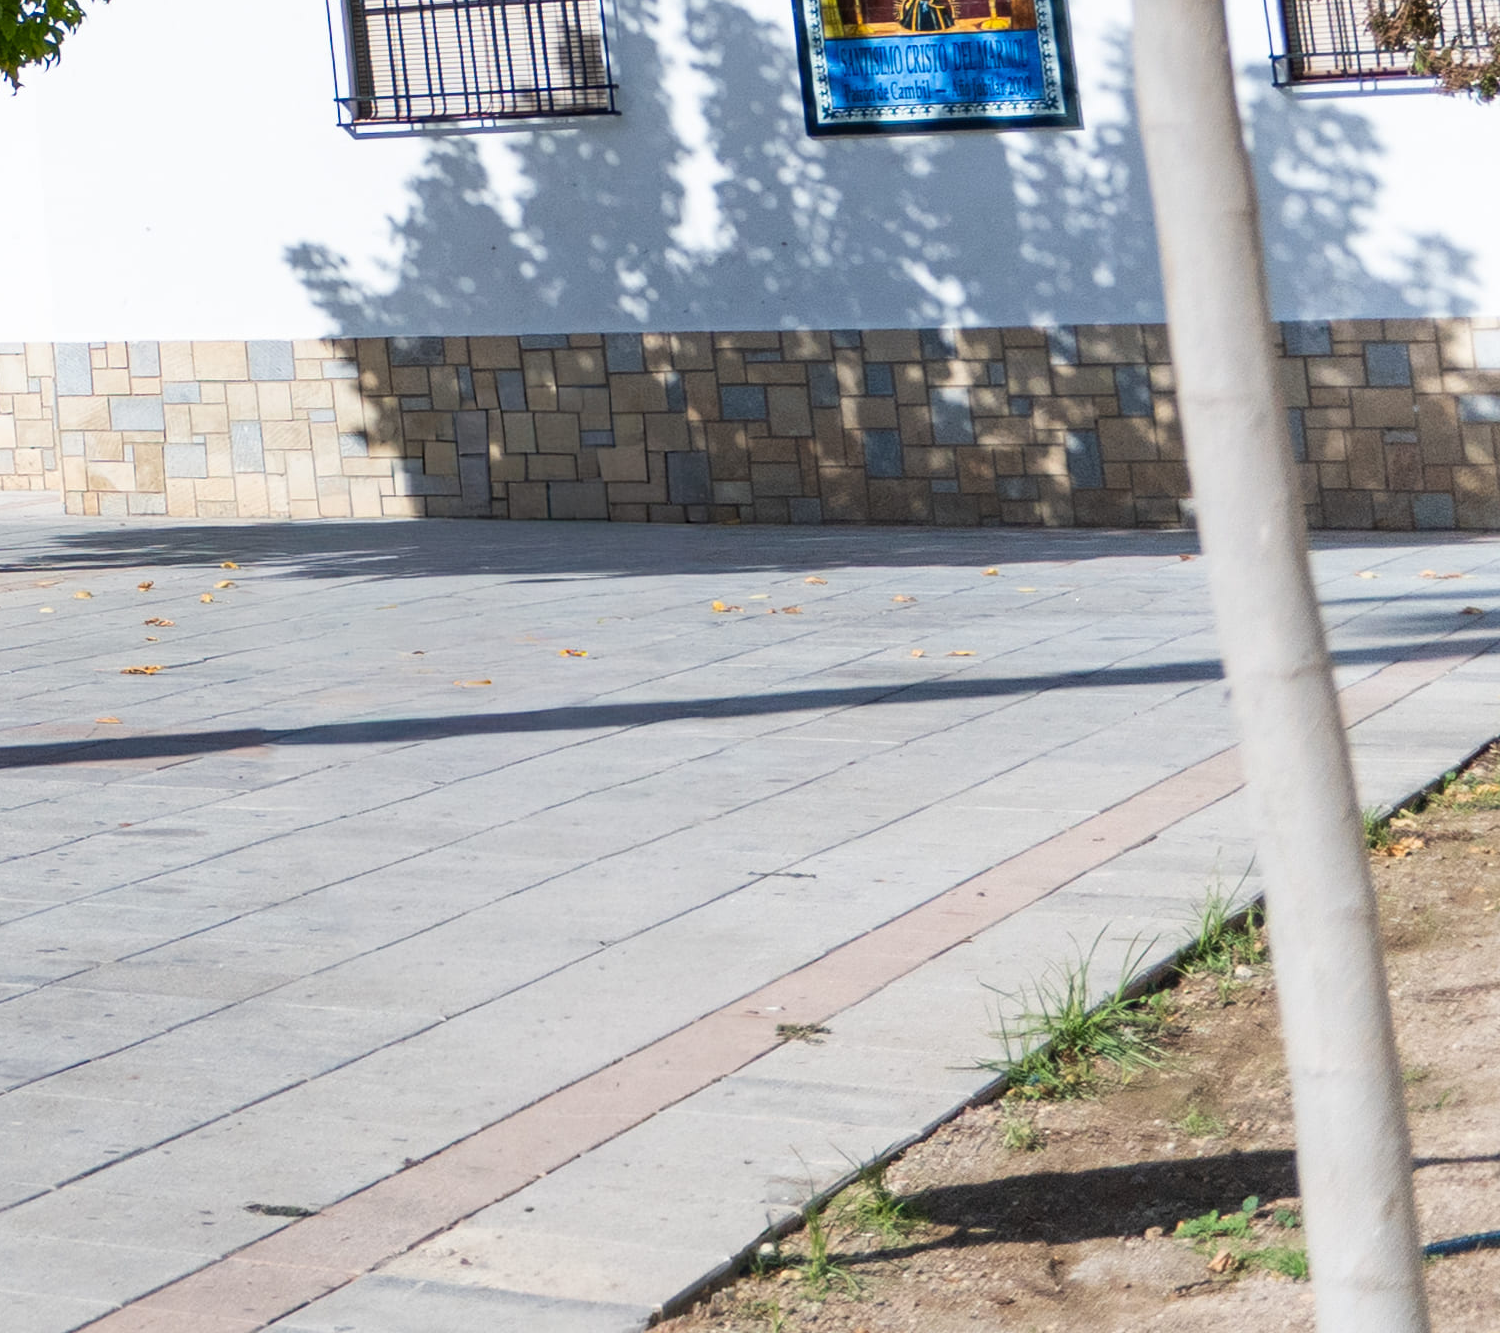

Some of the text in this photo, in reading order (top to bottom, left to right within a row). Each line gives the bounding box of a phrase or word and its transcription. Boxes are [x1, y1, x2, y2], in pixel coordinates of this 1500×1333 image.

[841, 38, 1028, 77] SANTISIMO CRISTO DEL MARMOL
[876, 82, 889, 101] de
[890, 79, 931, 100] Cambil
[952, 79, 971, 97] Año
